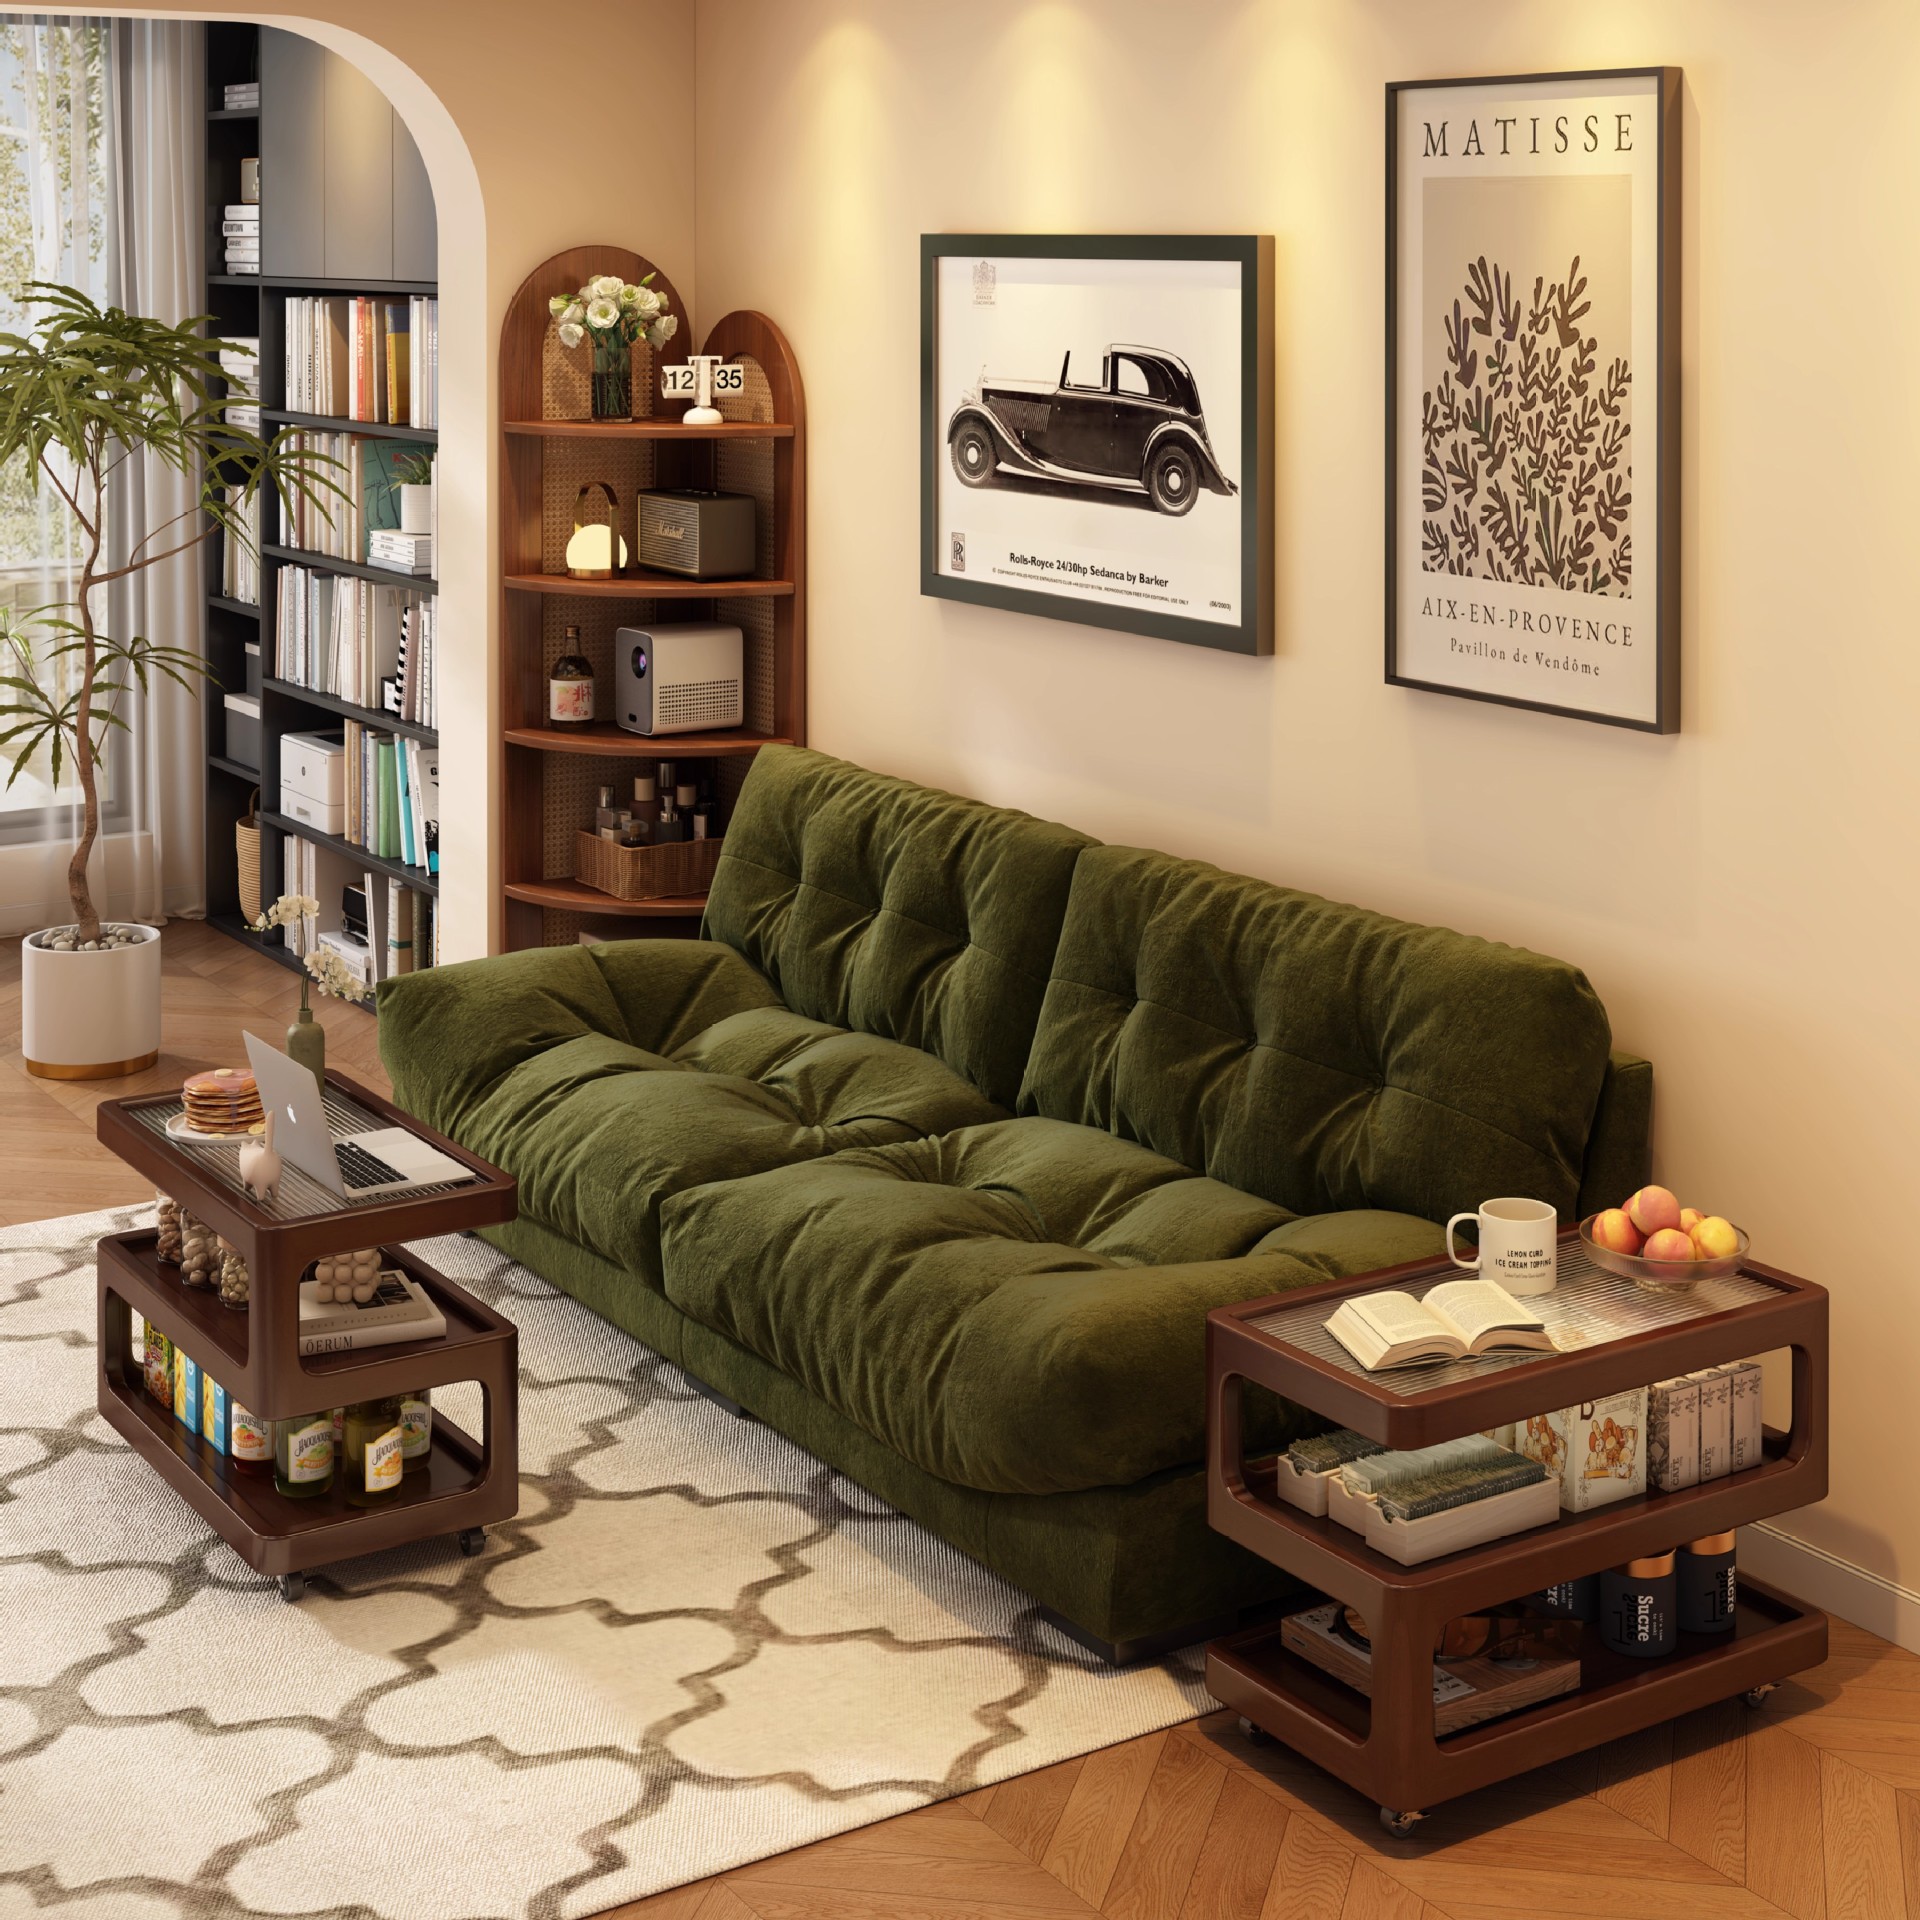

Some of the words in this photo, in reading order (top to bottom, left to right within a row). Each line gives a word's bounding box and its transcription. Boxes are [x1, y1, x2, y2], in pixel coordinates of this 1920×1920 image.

[1422, 113, 1633, 157] MATISSE
[668, 370, 694, 390] 12
[716, 369, 742, 389] 35
[1009, 552, 1054, 570] Rolls-Royce
[1056, 559, 1088, 577] 24/30hp
[1090, 564, 1125, 582] Sedanca
[1126, 570, 1137, 588] by
[1138, 572, 1169, 588] Barker
[1422, 596, 1633, 647] AIX-EN-PROVENCE
[1450, 638, 1506, 660] Pavillon
[1513, 648, 1528, 664] de
[1535, 651, 1600, 676] Vendôme
[1495, 1258, 1506, 1268] ICE
[1508, 1260, 1528, 1269] CREAM
[1530, 1258, 1552, 1269] TOPPING
[1507, 1250, 1527, 1258] LEMON
[1529, 1250, 1544, 1258] CURD
[1727, 1564, 1736, 1614] Sucre
[1638, 1595, 1654, 1642] Sucre
